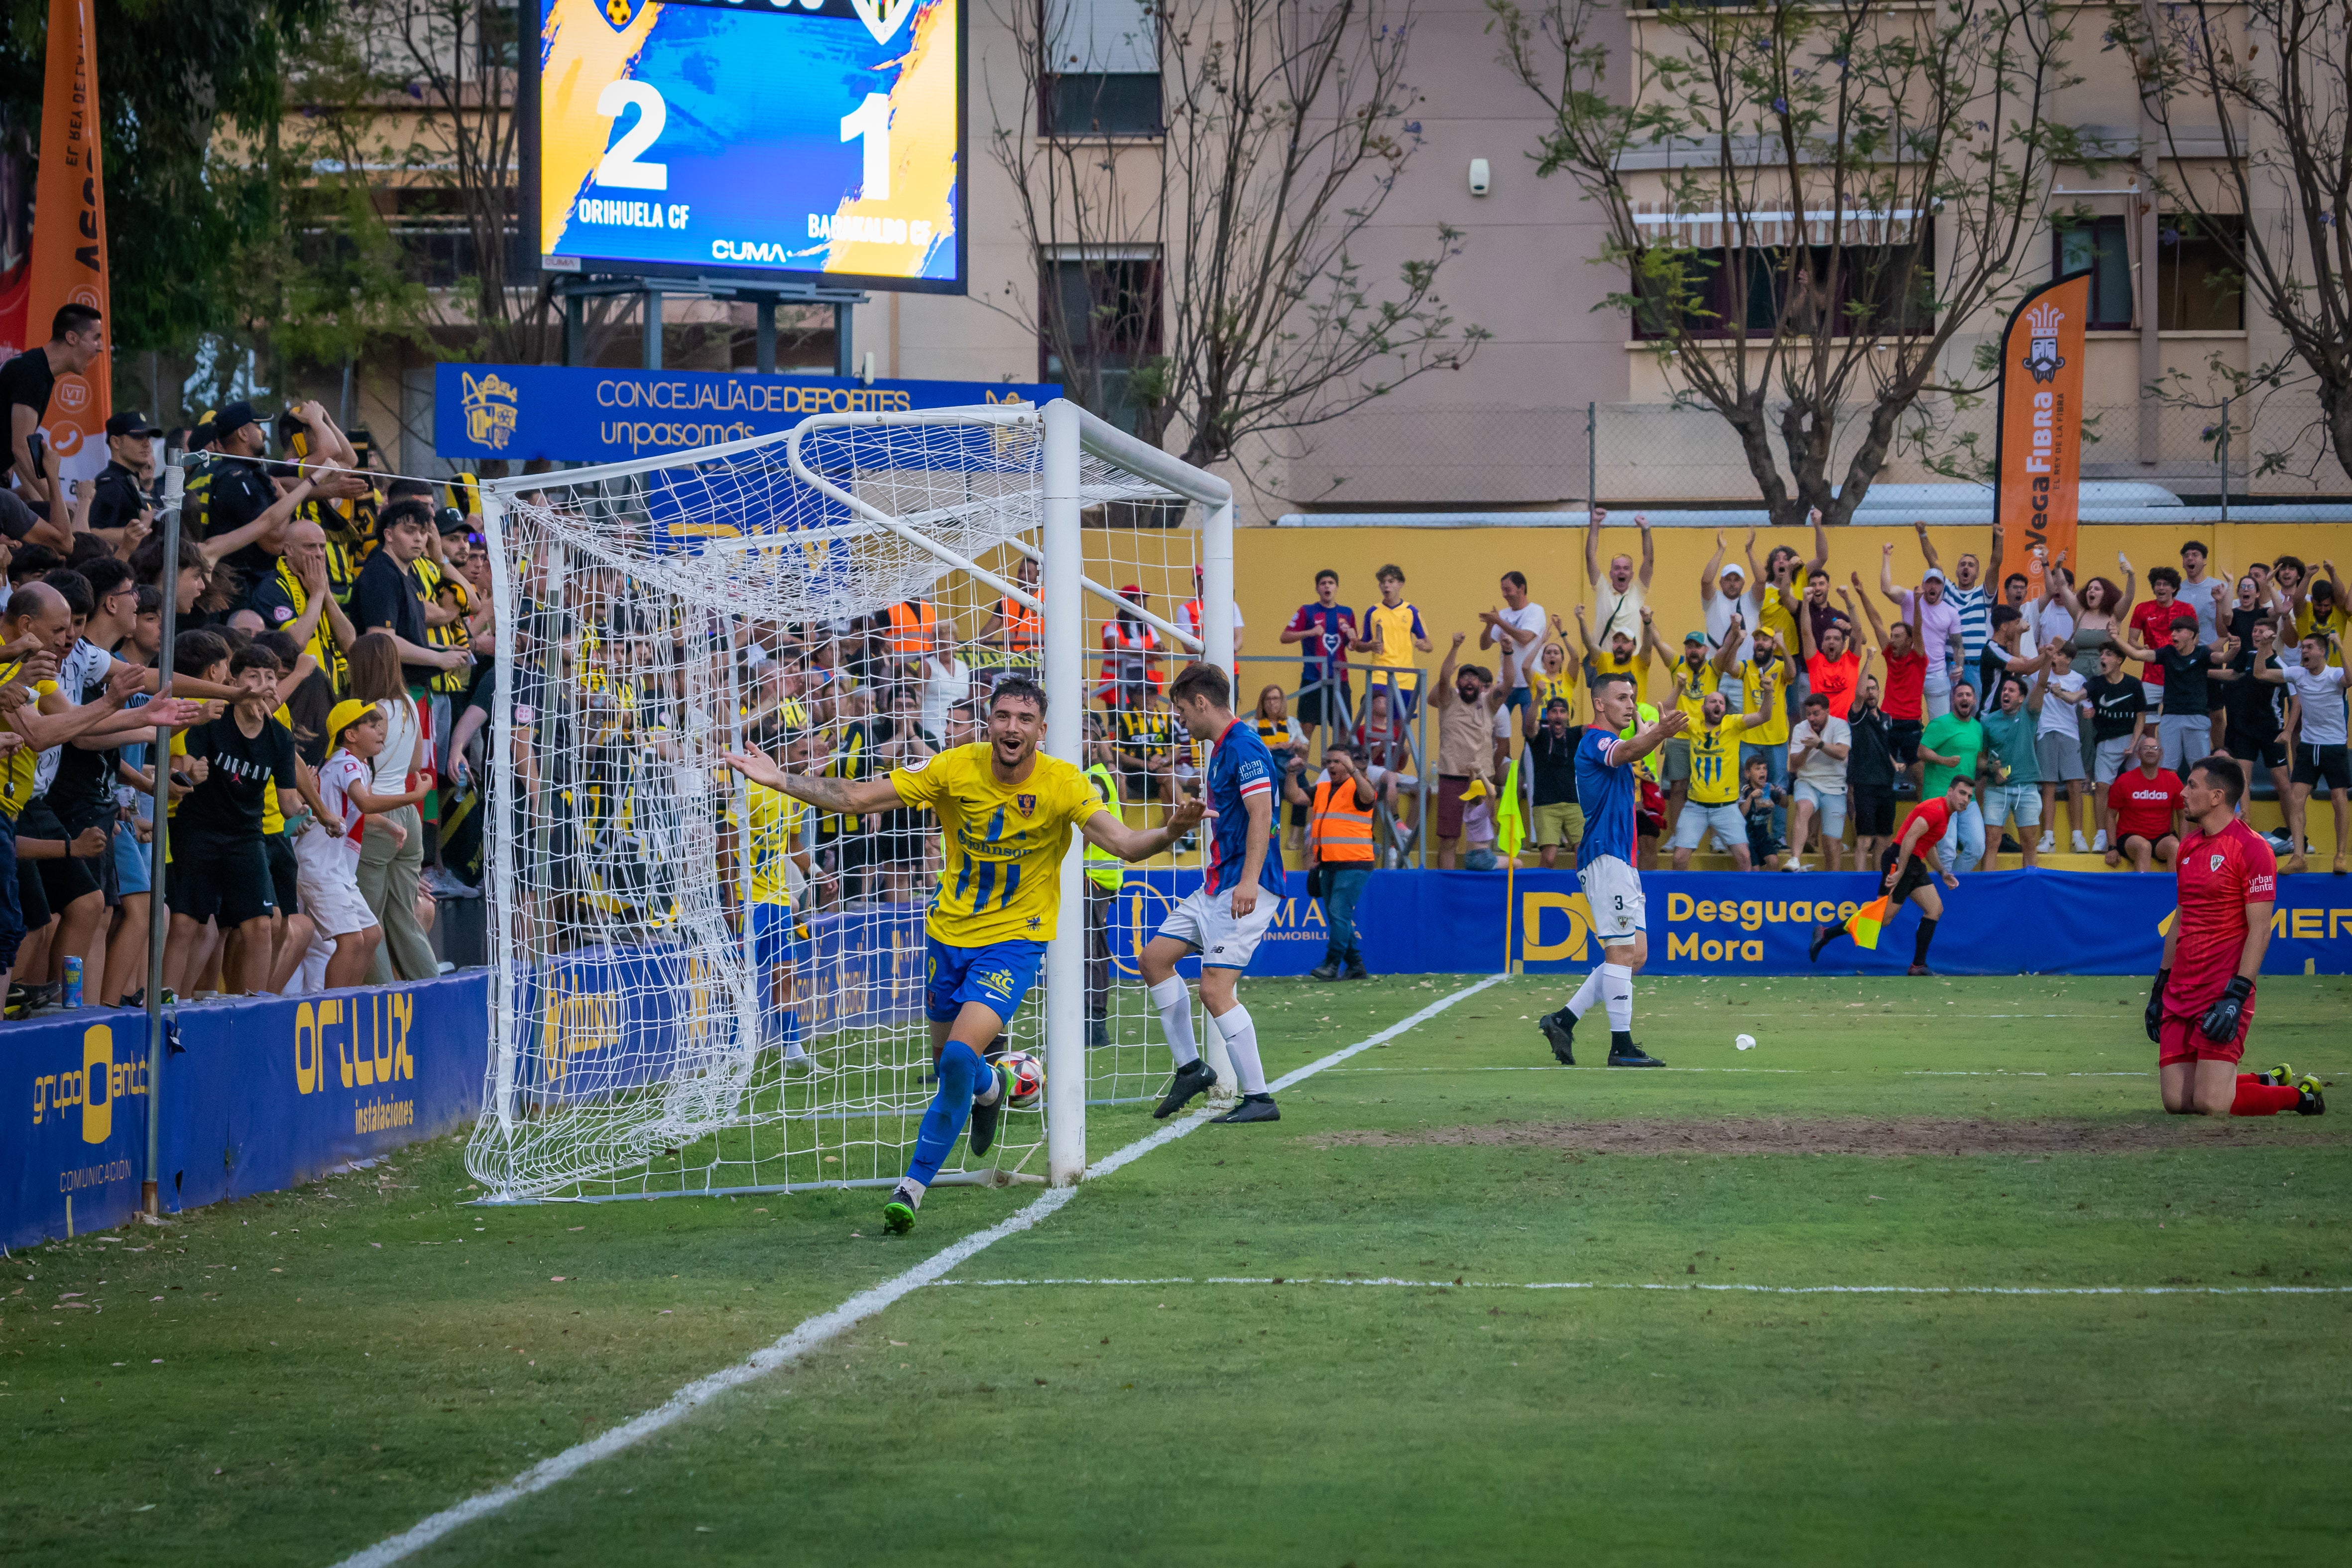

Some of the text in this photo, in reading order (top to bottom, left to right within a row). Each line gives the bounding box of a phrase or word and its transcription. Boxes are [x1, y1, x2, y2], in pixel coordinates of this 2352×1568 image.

[596, 79, 668, 190] 2
[840, 92, 890, 199] 1
[579, 199, 690, 230] ORIHUELA CF
[910, 220, 932, 246] CF
[544, 256, 576, 268] CUMA
[712, 240, 787, 263] CUMA
[2056, 392, 2064, 422] FIBRA
[2056, 425, 2063, 438] LA
[2055, 442, 2062, 454] DE
[2053, 478, 2060, 490] EL
[215, 752, 271, 781] JORDAN
[2132, 789, 2168, 800] adidas
[968, 837, 1033, 858] johnson
[2249, 873, 2273, 885] urban
[1615, 895, 1624, 911] 3
[1263, 930, 1362, 941] INMOBILIA
[1667, 932, 1764, 962] Mora
[928, 956, 937, 984] 9
[355, 1093, 414, 1135] instalaciones
[60, 1151, 131, 1193] COMUNICACIÓN
